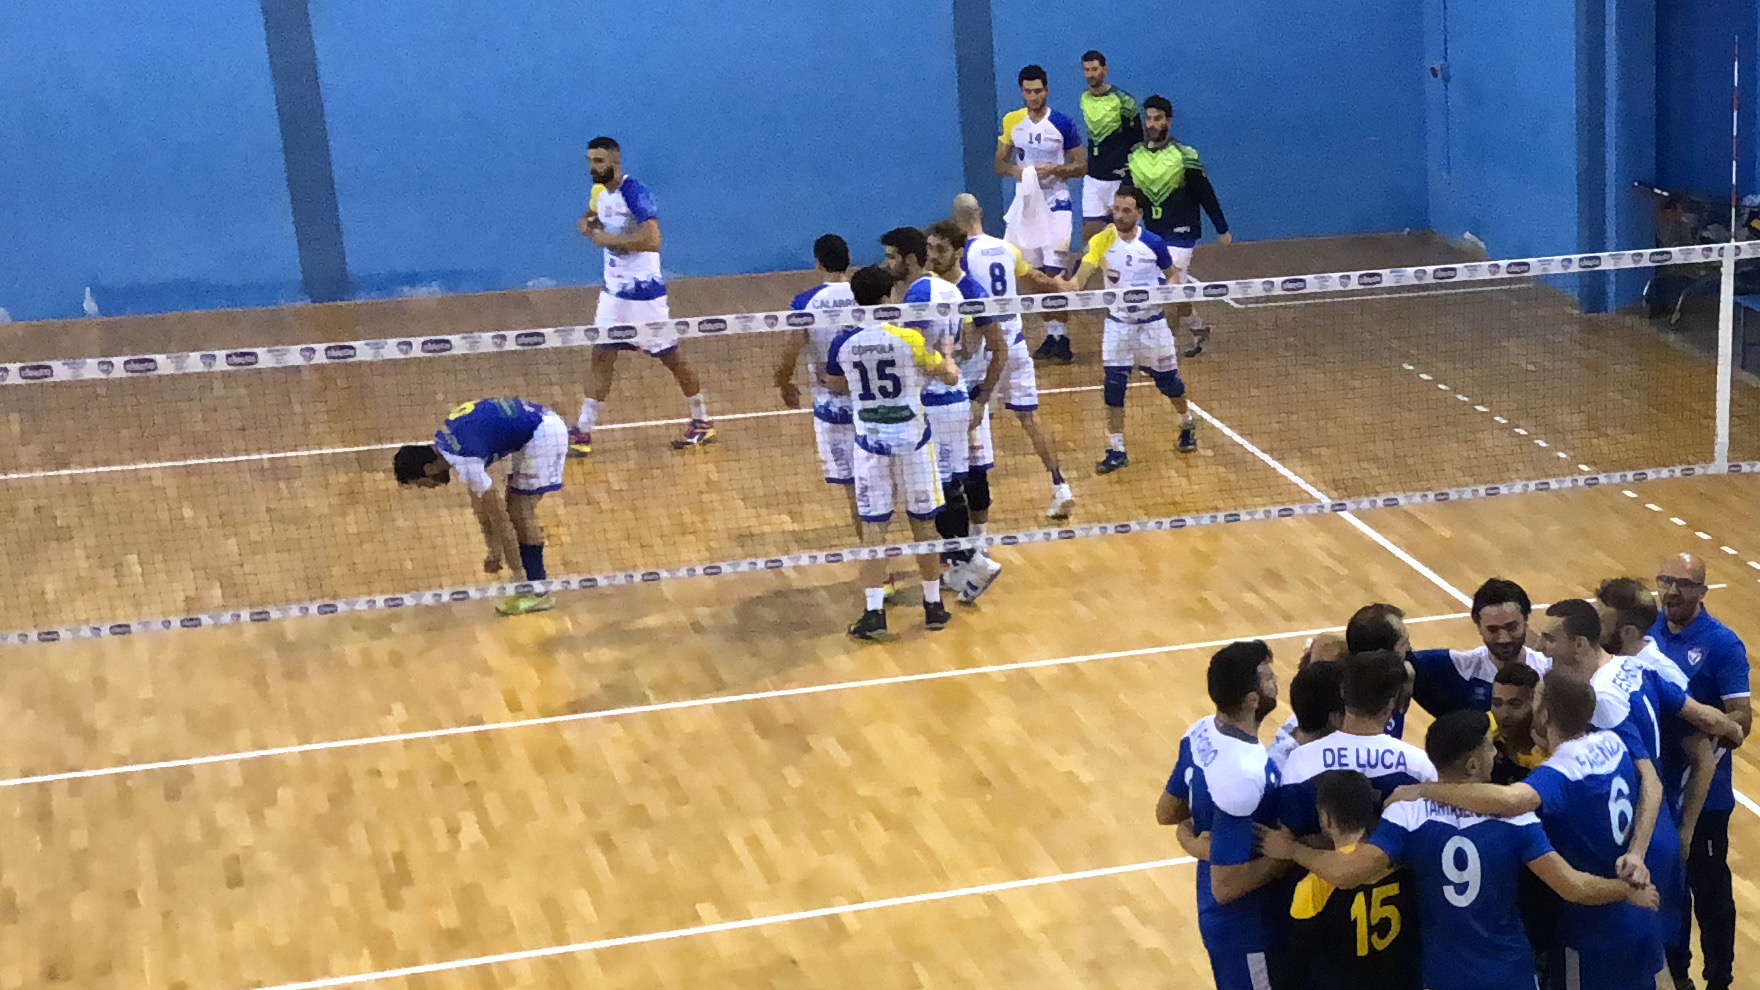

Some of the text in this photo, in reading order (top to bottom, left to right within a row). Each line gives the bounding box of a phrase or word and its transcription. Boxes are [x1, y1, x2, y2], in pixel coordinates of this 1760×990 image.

[988, 261, 1008, 297] 8
[812, 298, 856, 309] CALABR
[852, 359, 902, 401] 15
[1322, 747, 1408, 771] DE LUCA
[1608, 776, 1634, 846] 6
[1441, 835, 1482, 908] 9
[1350, 881, 1402, 957] 15
